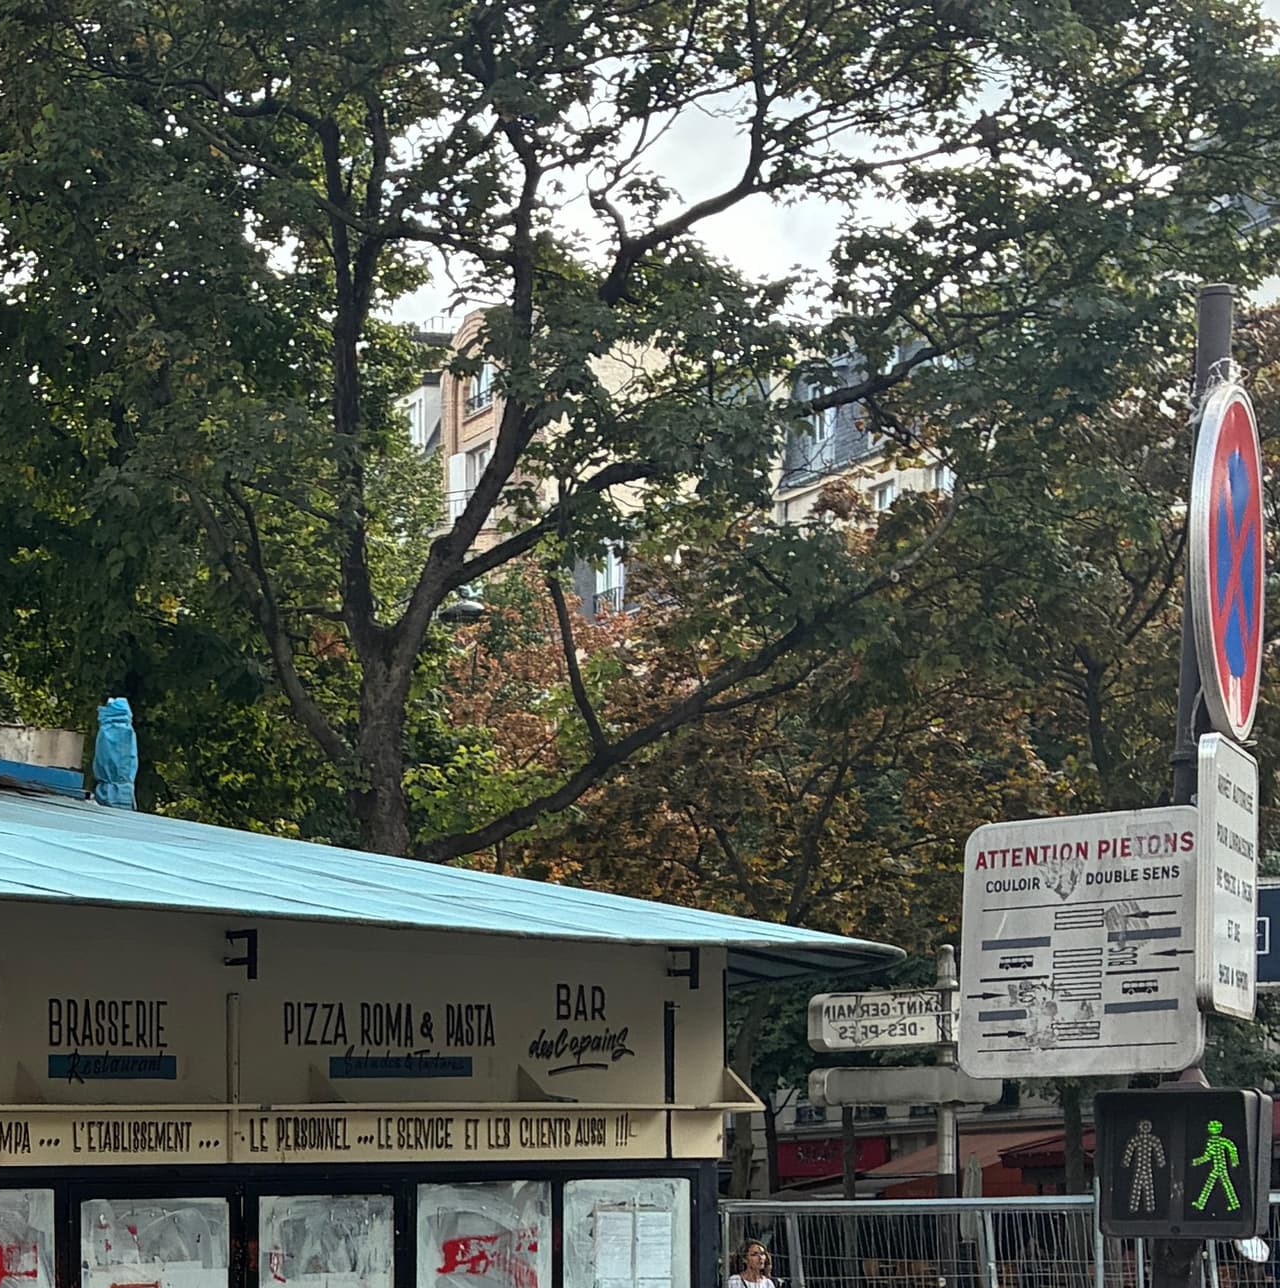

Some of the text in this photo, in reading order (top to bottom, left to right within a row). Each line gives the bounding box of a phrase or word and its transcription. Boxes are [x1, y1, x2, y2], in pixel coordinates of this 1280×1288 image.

[975, 831, 1195, 870] ATTENTION PIETONS
[986, 865, 1181, 893] COULOIR DOUBLE SENS
[556, 983, 607, 1021] BAR
[48, 998, 168, 1048] BRASSERIE
[283, 1002, 496, 1048] PIZZA ROMA & PASTA
[66, 1048, 163, 1084] Restaurant
[72, 1121, 192, 1154] L'ETABLISSEMENT
[249, 1118, 269, 1152] LE
[276, 1117, 351, 1151] PERSONNEL
[376, 1118, 394, 1151] LE
[396, 1117, 454, 1150] SERVICE
[464, 1117, 481, 1150] ET
[487, 1117, 510, 1149] LES
[519, 1117, 571, 1149] CLIENTS
[574, 1117, 607, 1148] AUSSI
